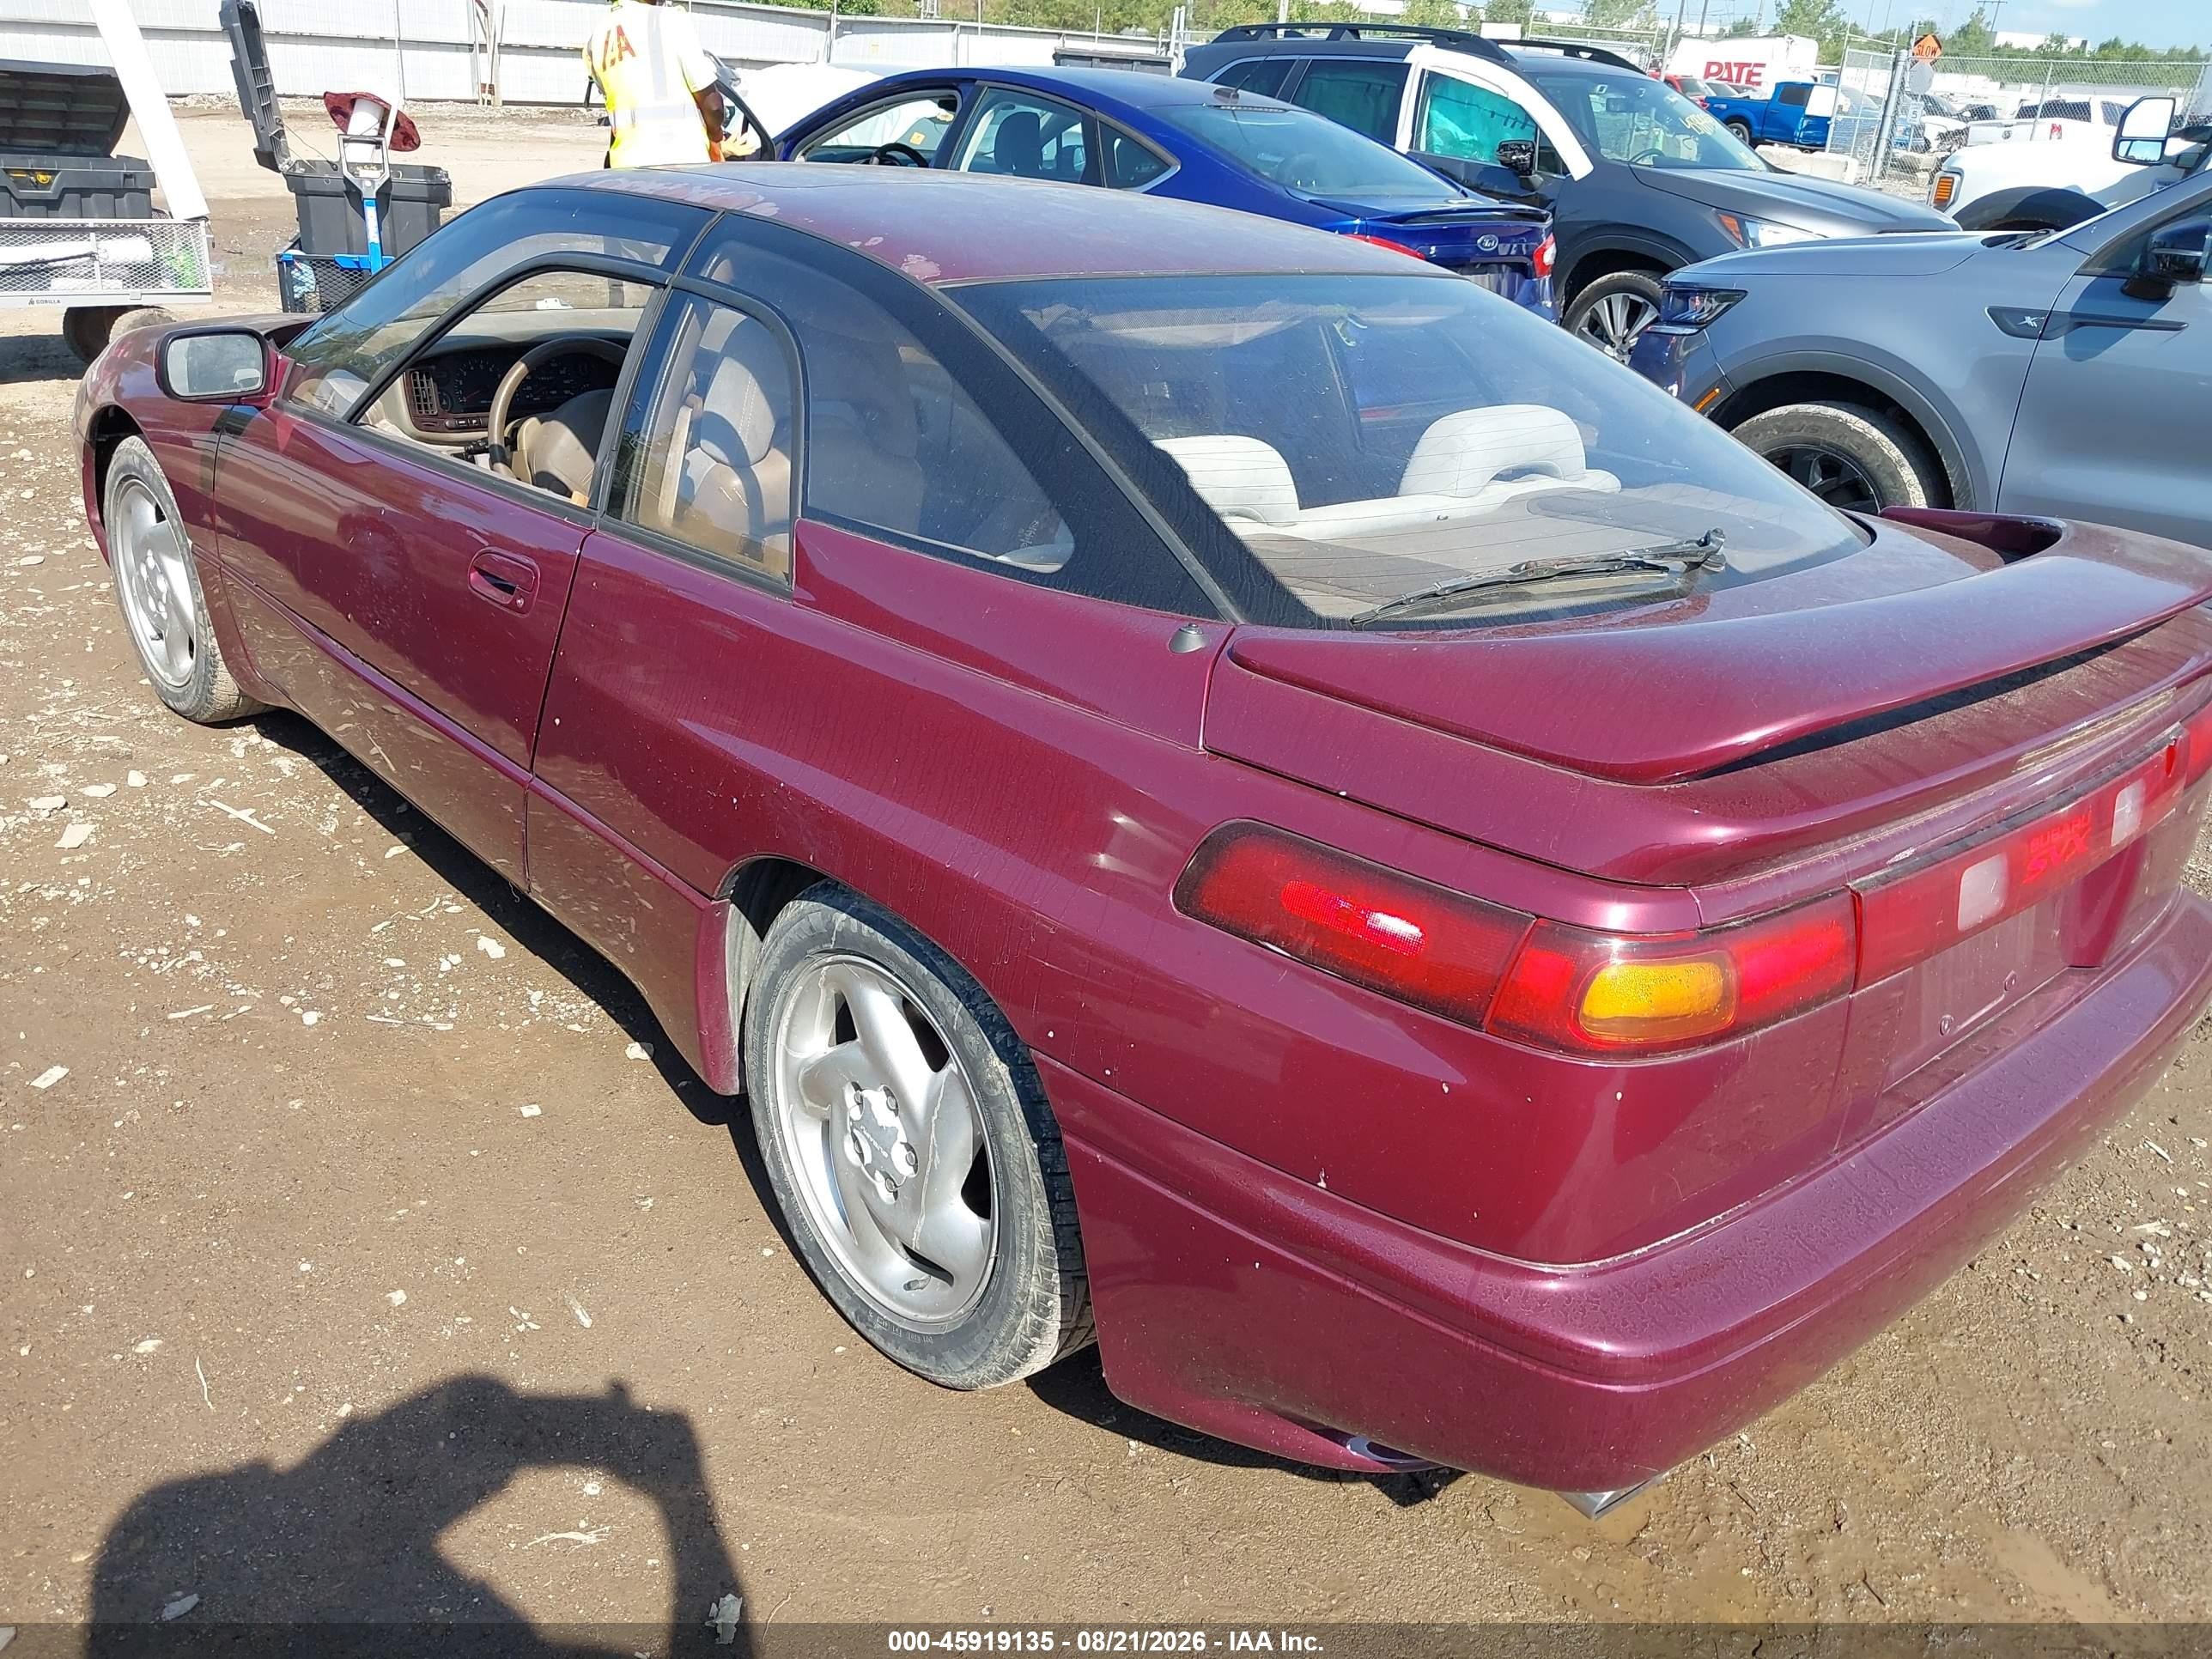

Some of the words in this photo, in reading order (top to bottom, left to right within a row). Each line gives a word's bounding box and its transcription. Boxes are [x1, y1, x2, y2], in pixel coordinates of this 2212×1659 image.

[1916, 44, 1938, 57] SLOW
[1704, 62, 1766, 86] PATE
[1911, 110, 1917, 118] 5
[2030, 811, 2091, 854] SUBARU
[2021, 829, 2091, 886] SVX
